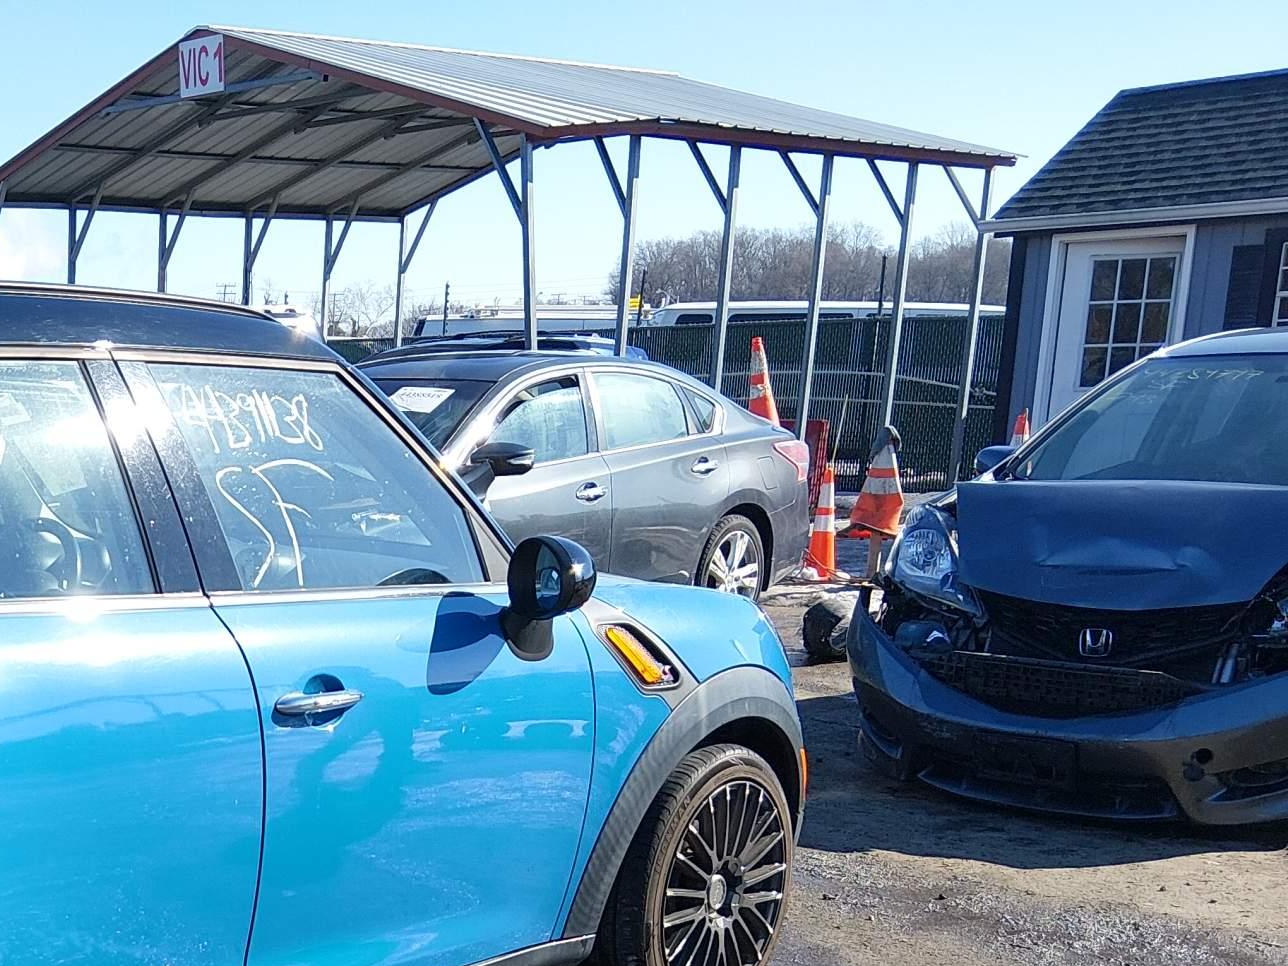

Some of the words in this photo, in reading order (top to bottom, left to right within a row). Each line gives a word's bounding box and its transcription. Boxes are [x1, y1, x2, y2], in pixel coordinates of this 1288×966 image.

[180, 45, 209, 89] VIC
[214, 42, 222, 83] 1
[215, 458, 335, 587] SF
